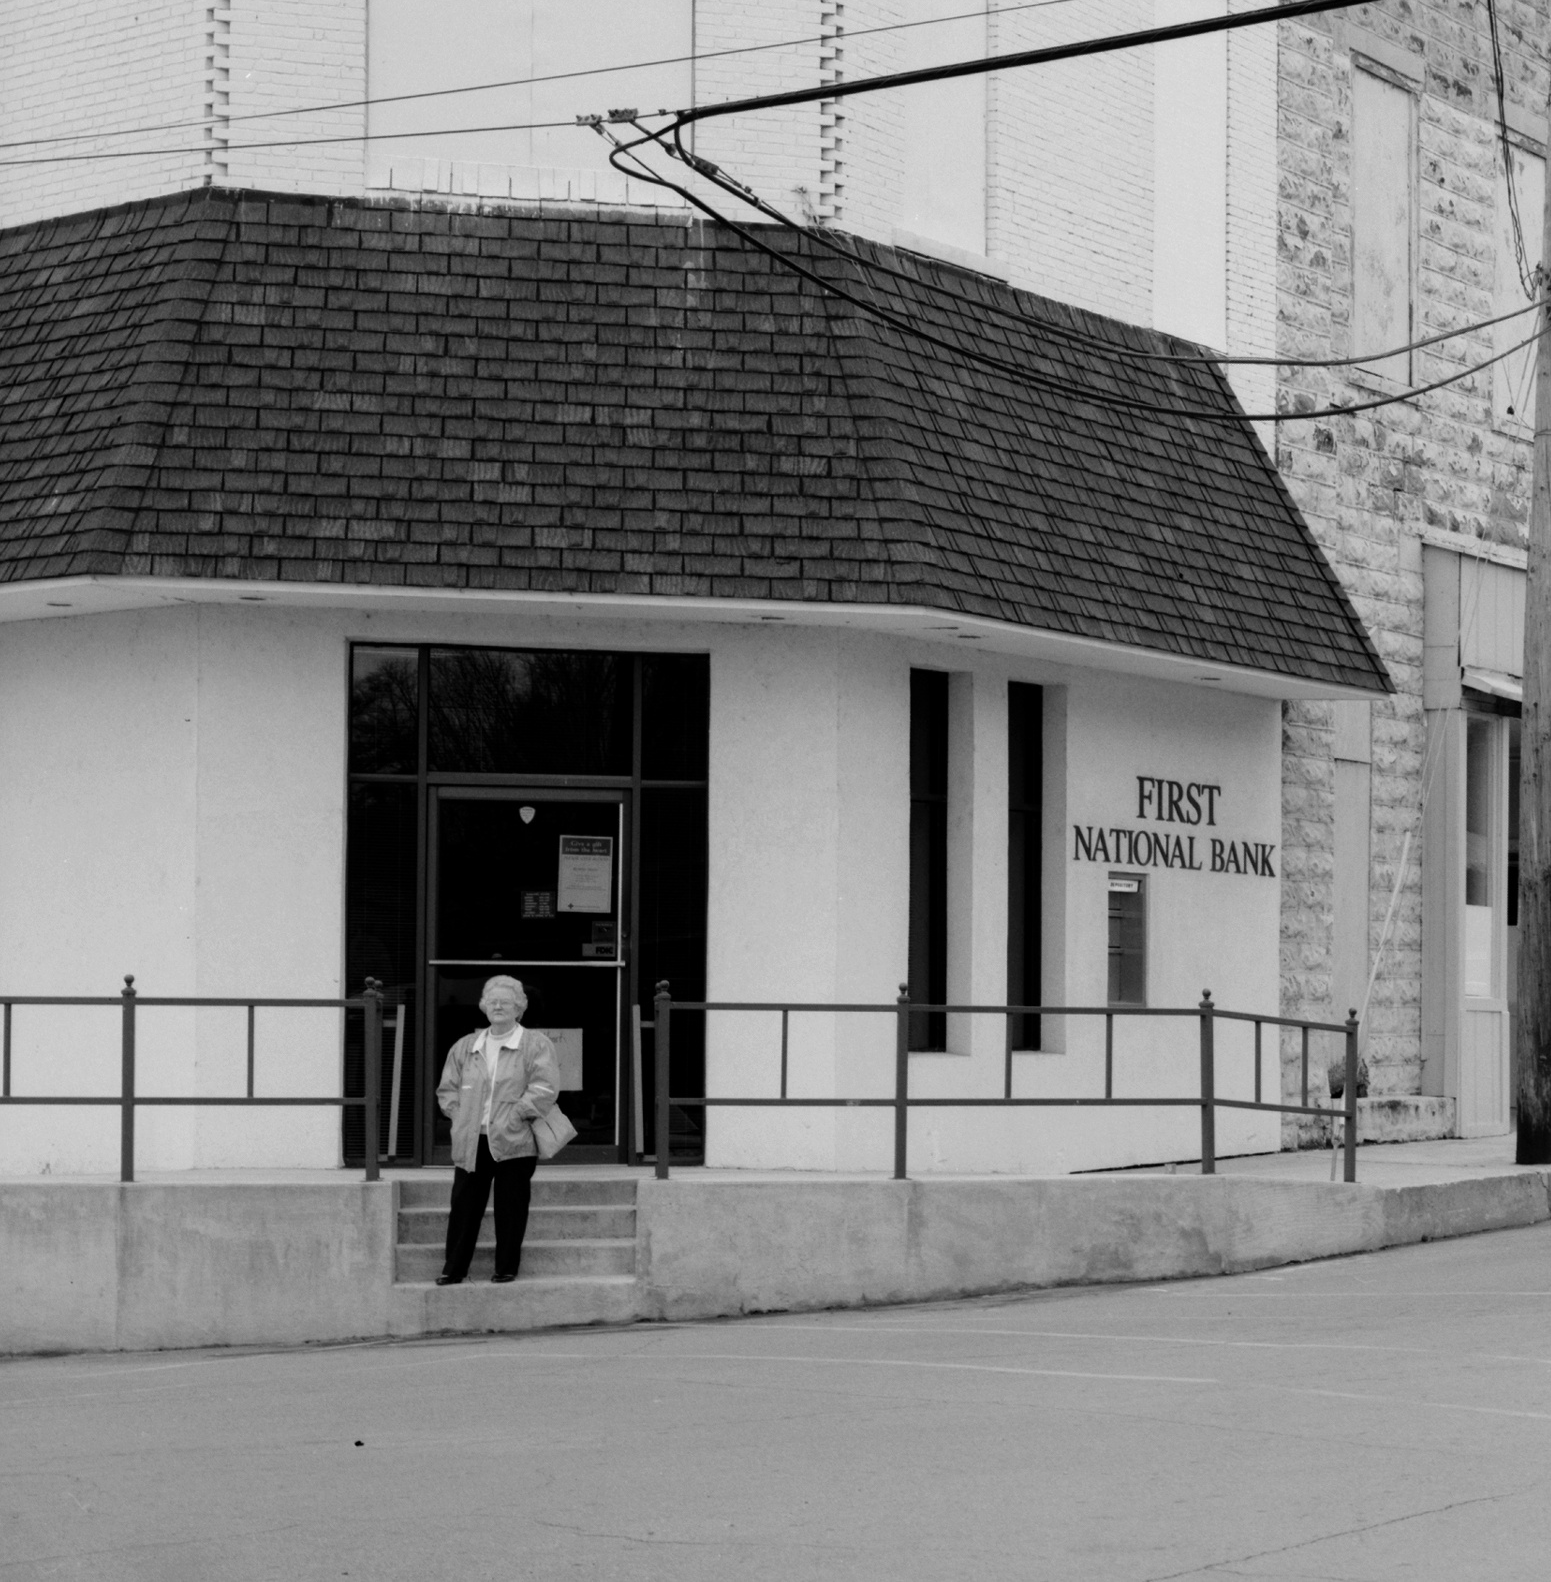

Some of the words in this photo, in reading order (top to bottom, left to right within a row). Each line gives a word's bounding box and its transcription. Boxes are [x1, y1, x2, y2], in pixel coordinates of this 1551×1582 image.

[1136, 775, 1222, 827] FIRST
[1073, 824, 1203, 871] NATIONAL
[1210, 838, 1276, 878] BANK
[595, 946, 613, 955] FDIC
